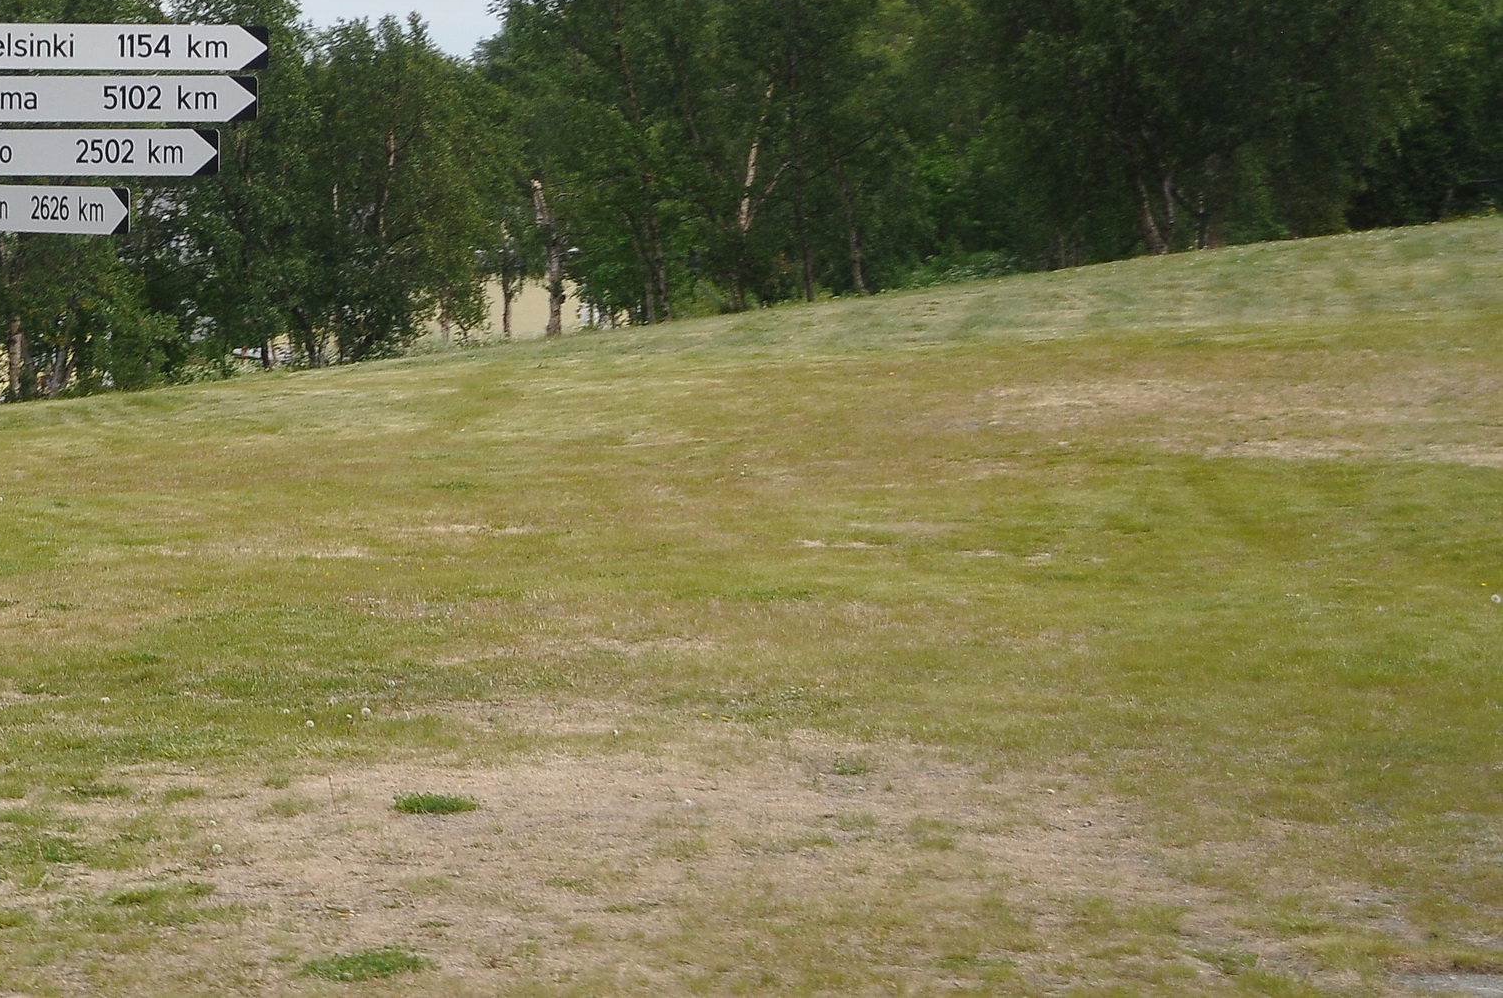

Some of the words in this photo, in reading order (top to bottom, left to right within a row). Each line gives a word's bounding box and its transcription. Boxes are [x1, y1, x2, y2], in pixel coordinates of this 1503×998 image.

[117, 33, 172, 58] 1154
[187, 33, 228, 59] km
[103, 84, 162, 110] 5102
[177, 84, 217, 110] km
[75, 138, 135, 164] 2502
[148, 138, 184, 165] km
[30, 194, 70, 221] 2626
[78, 195, 104, 223] km
